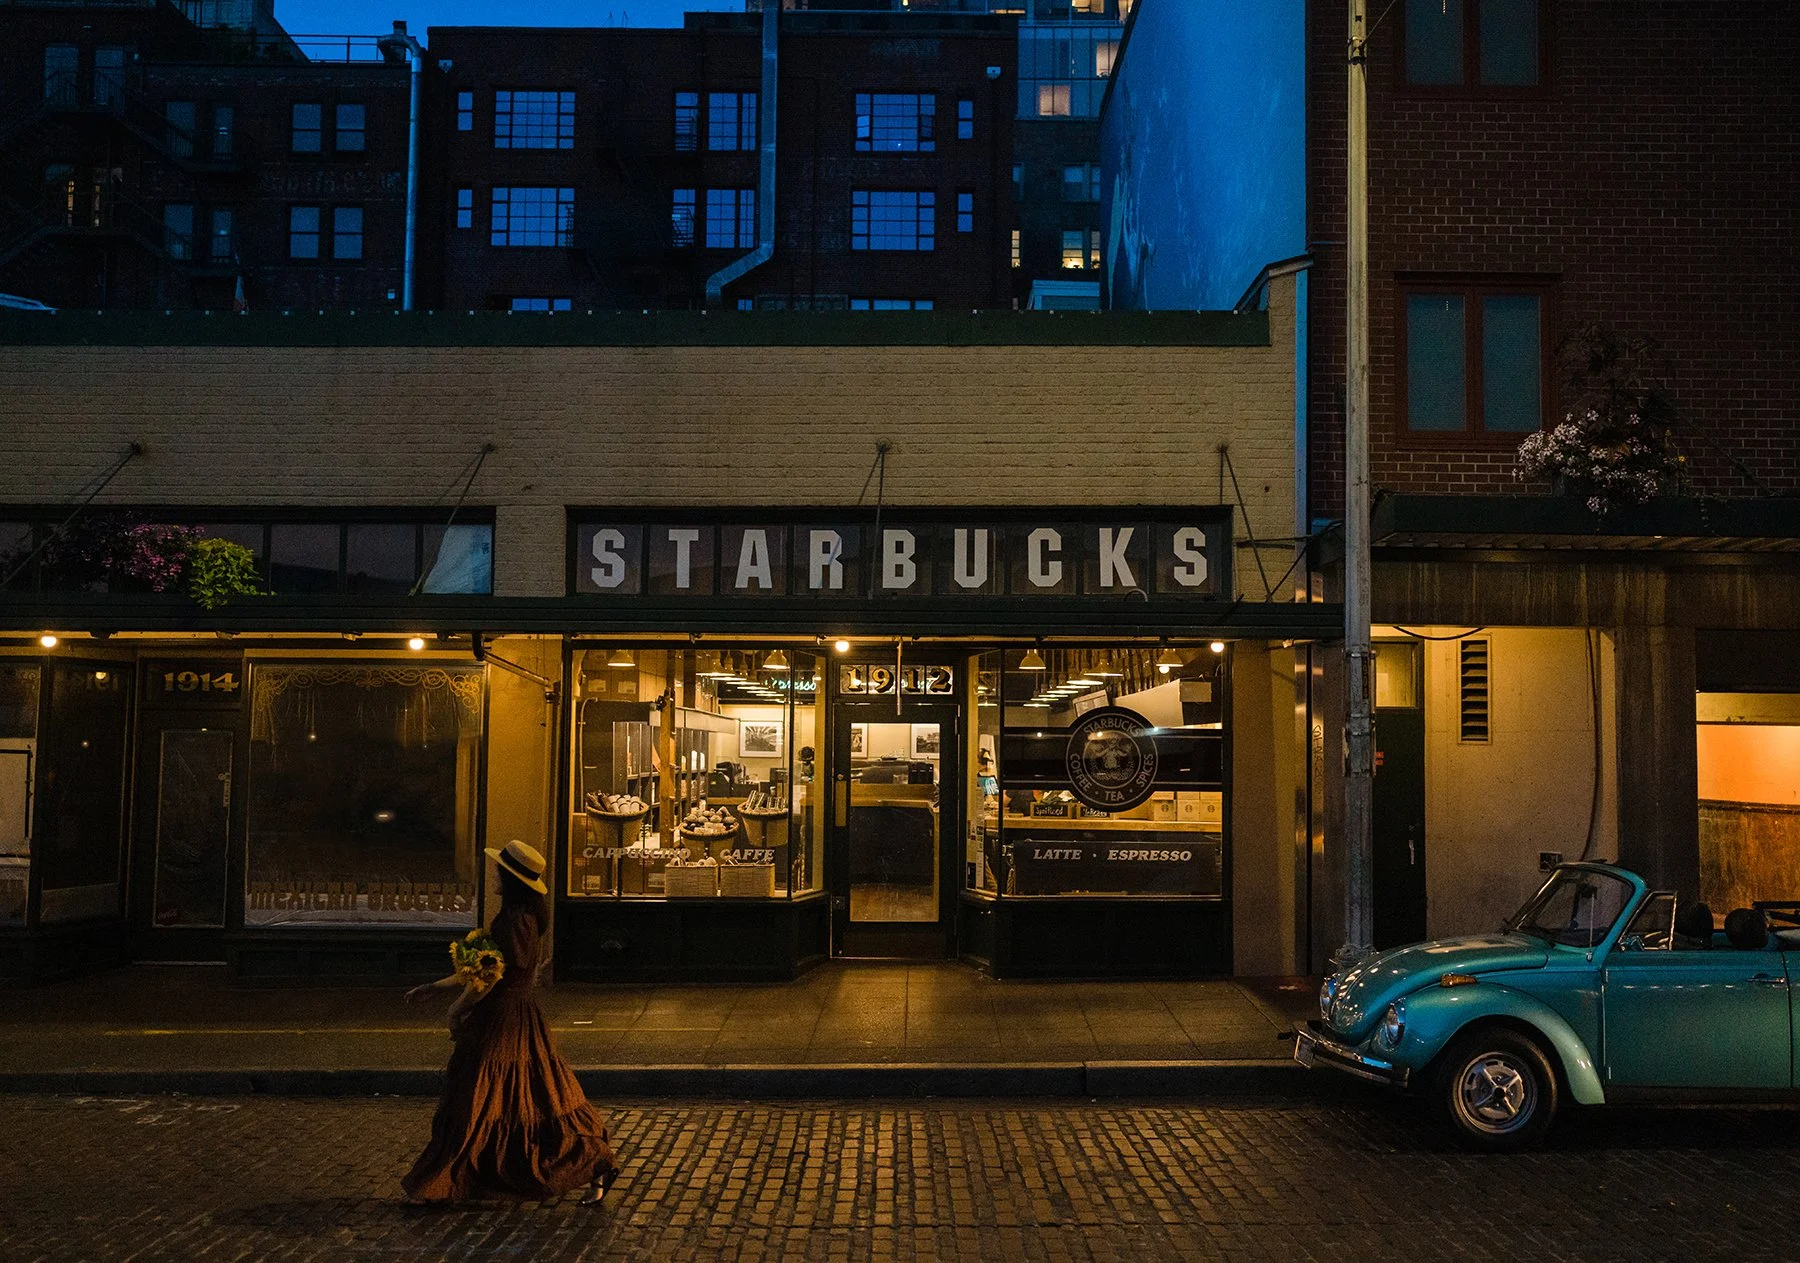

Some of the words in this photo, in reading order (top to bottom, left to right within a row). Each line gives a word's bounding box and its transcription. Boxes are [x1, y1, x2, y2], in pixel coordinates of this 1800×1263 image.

[591, 527, 1207, 588] STARBUCKS
[163, 671, 239, 693] 1914
[847, 667, 952, 693] 1912
[1083, 717, 1141, 738] STARBUCKS
[1069, 753, 1092, 792] COFFEE
[1104, 790, 1125, 801] TEA
[1136, 753, 1154, 788] SPICES
[583, 847, 692, 860] CAPPUCCINO
[1032, 849, 1082, 860] LATTE
[1107, 849, 1192, 862] ESPRESSO
[251, 881, 358, 911] MEXICAN
